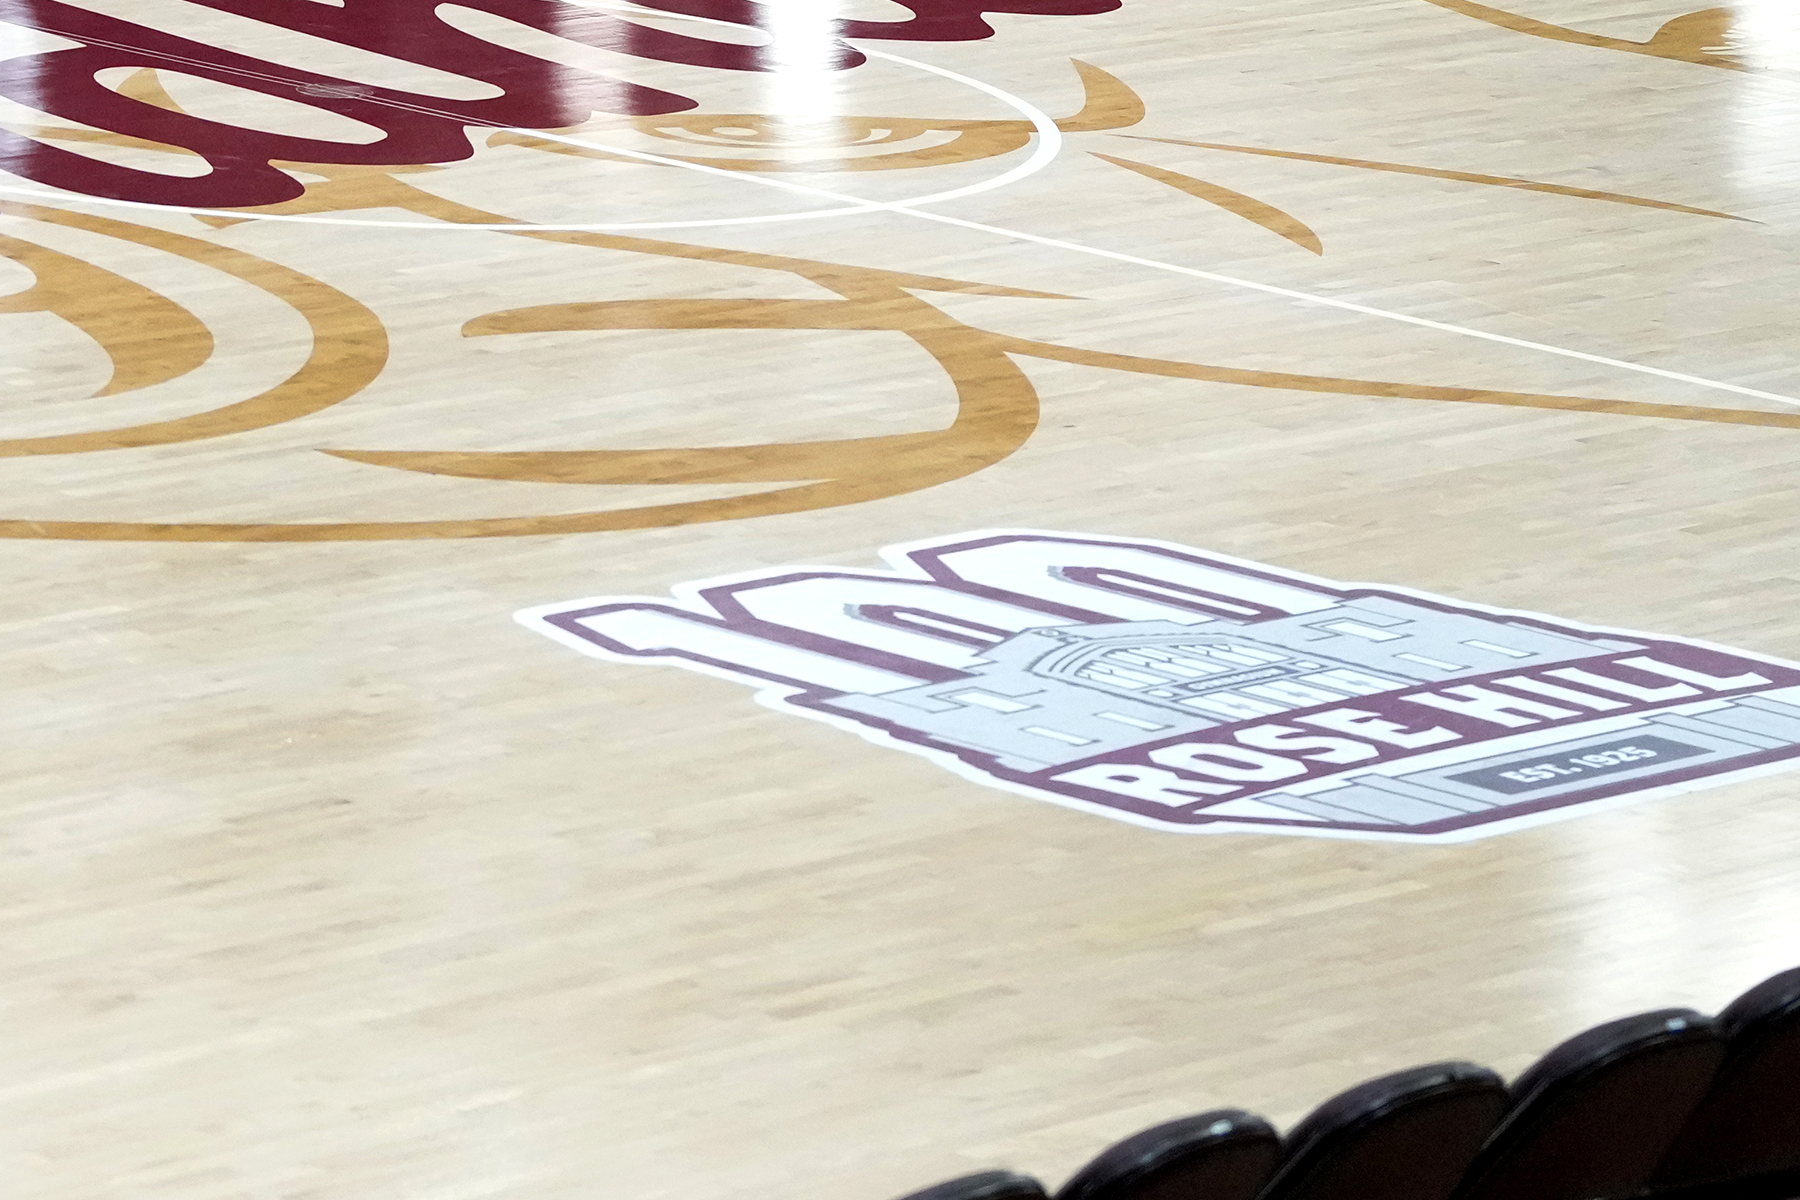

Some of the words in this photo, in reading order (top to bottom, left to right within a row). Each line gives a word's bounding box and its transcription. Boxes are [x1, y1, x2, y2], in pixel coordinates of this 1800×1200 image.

[1048, 706, 1463, 808] ROSE
[1398, 655, 1775, 729] HILL
[1498, 762, 1584, 784] EST.
[1569, 745, 1658, 769] 1925
